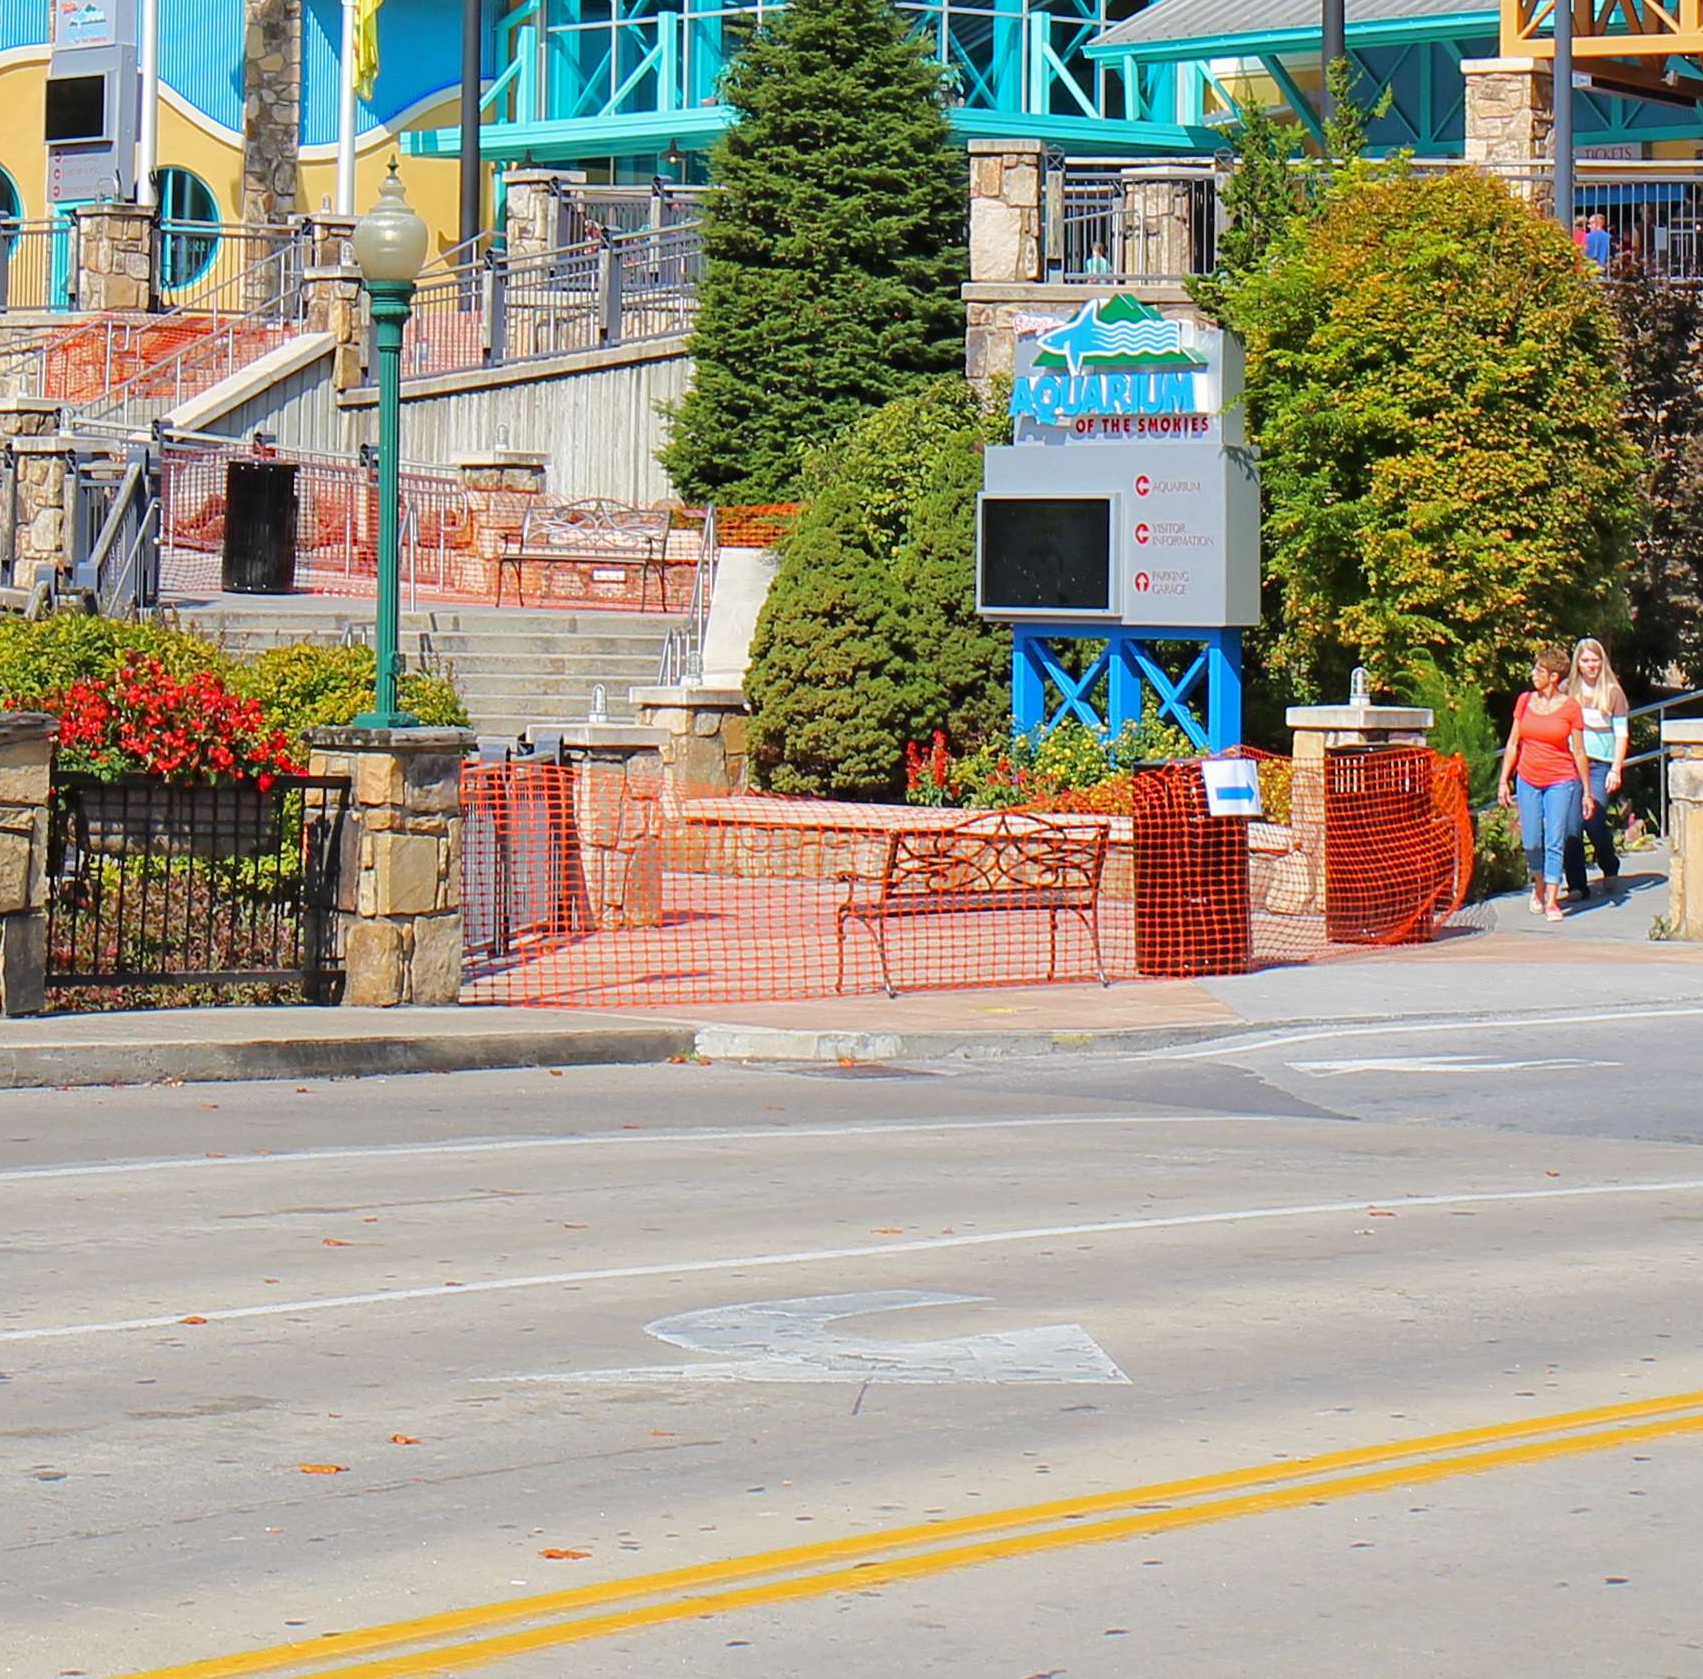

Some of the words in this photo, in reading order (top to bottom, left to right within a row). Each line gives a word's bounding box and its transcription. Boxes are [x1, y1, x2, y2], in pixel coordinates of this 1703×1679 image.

[1009, 372, 1195, 425] AQUARIUM
[1075, 417, 1094, 433] OF
[1103, 417, 1130, 433] THE
[1138, 417, 1209, 433] SMOKIES
[1152, 482, 1201, 493] AQUARIUM
[1152, 523, 1185, 534] VISITOR
[1152, 535, 1214, 546] INFORMATION
[1152, 571, 1189, 582] PARKING
